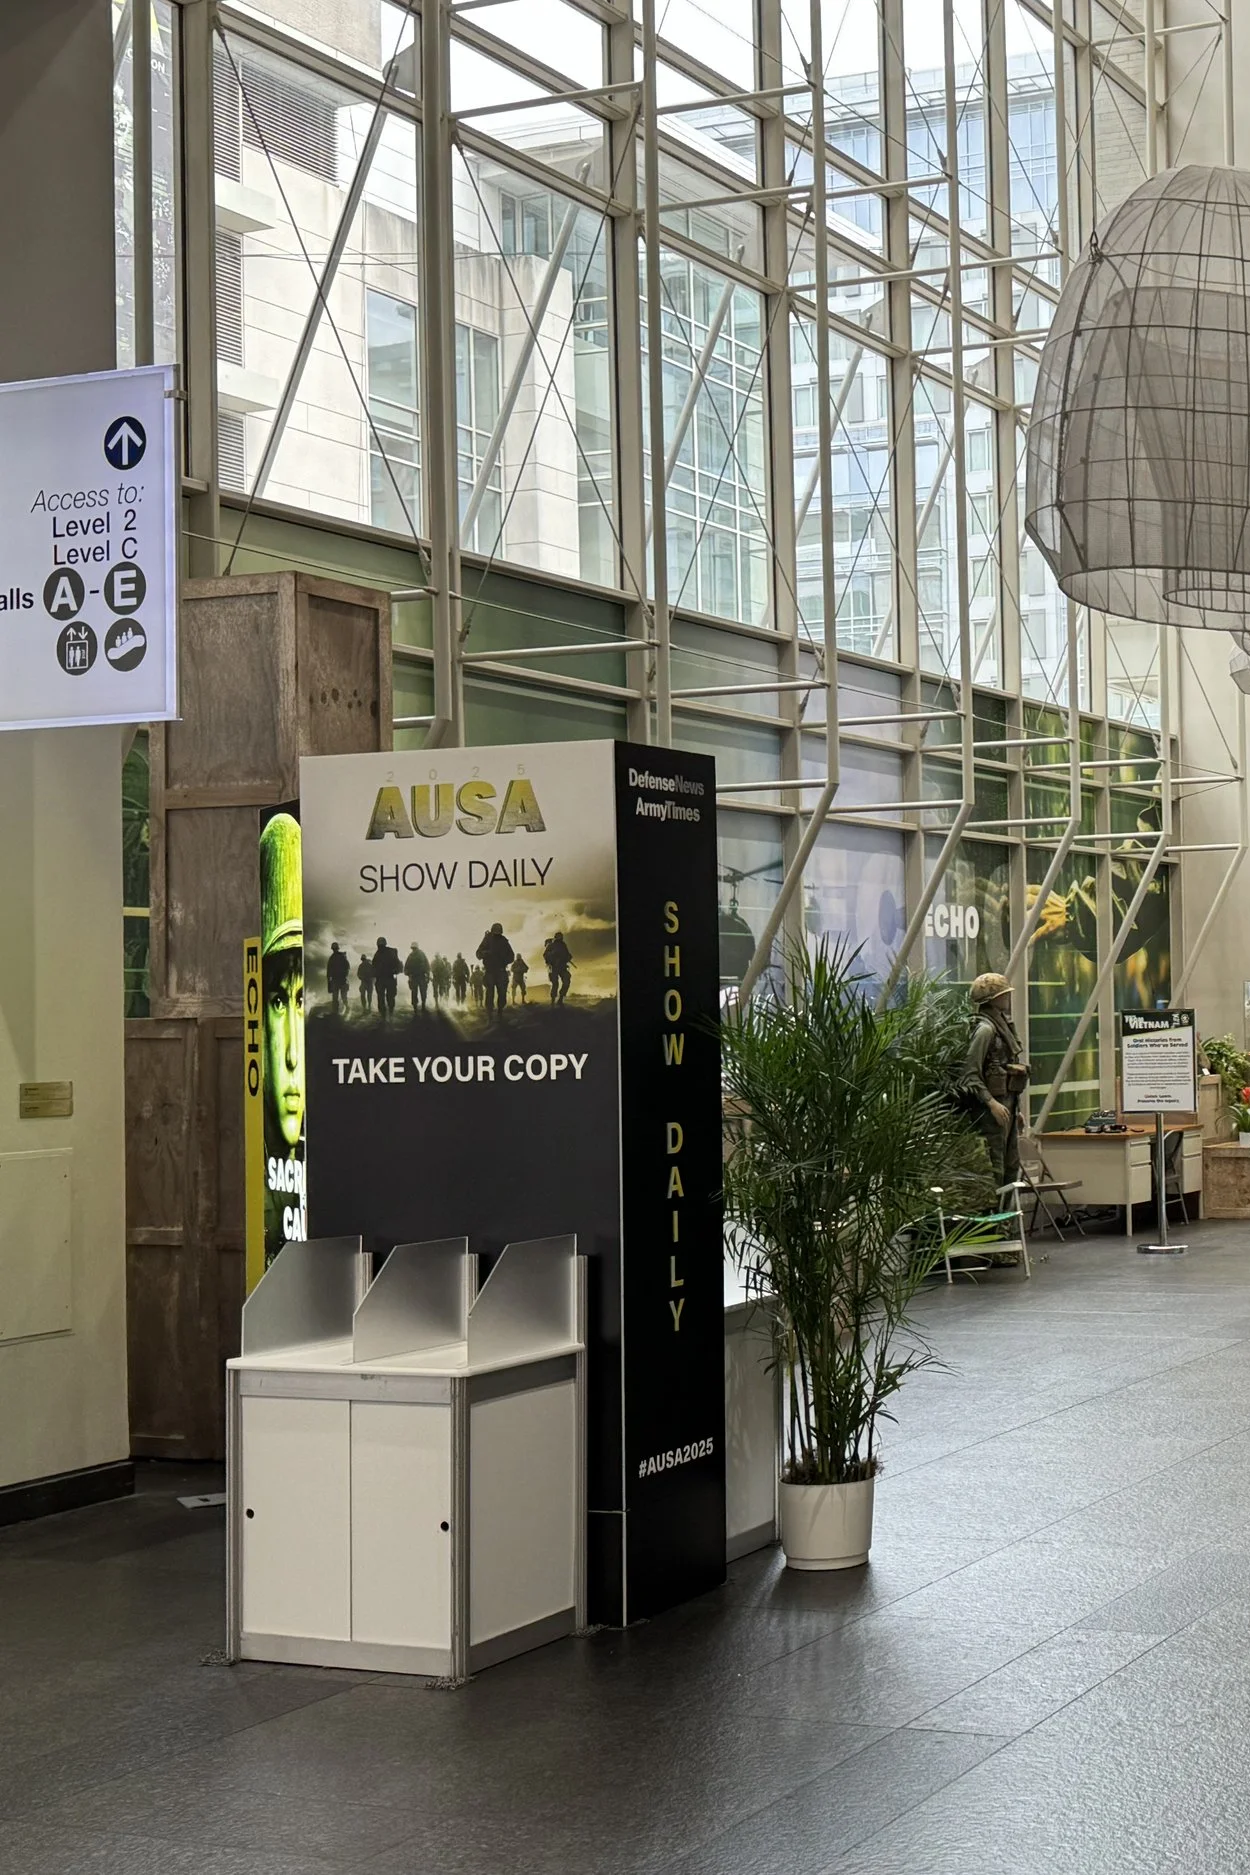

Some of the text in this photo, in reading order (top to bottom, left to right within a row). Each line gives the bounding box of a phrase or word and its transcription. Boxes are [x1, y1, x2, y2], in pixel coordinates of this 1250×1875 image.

[30, 482, 145, 514] Access to:
[52, 508, 137, 538] Level 2
[53, 537, 138, 566] Level C
[365, 779, 547, 841] AUSA
[359, 856, 554, 894] SHOW DAILY
[925, 903, 980, 939] ECHO
[661, 900, 687, 1066] SHOW
[246, 946, 259, 1098] ECHO
[1129, 1020, 1170, 1030] VIETNAM
[332, 1053, 589, 1084] TAKE YOUR COPY
[665, 1121, 688, 1333] DAILY
[638, 1436, 714, 1479] #AUSA2025
